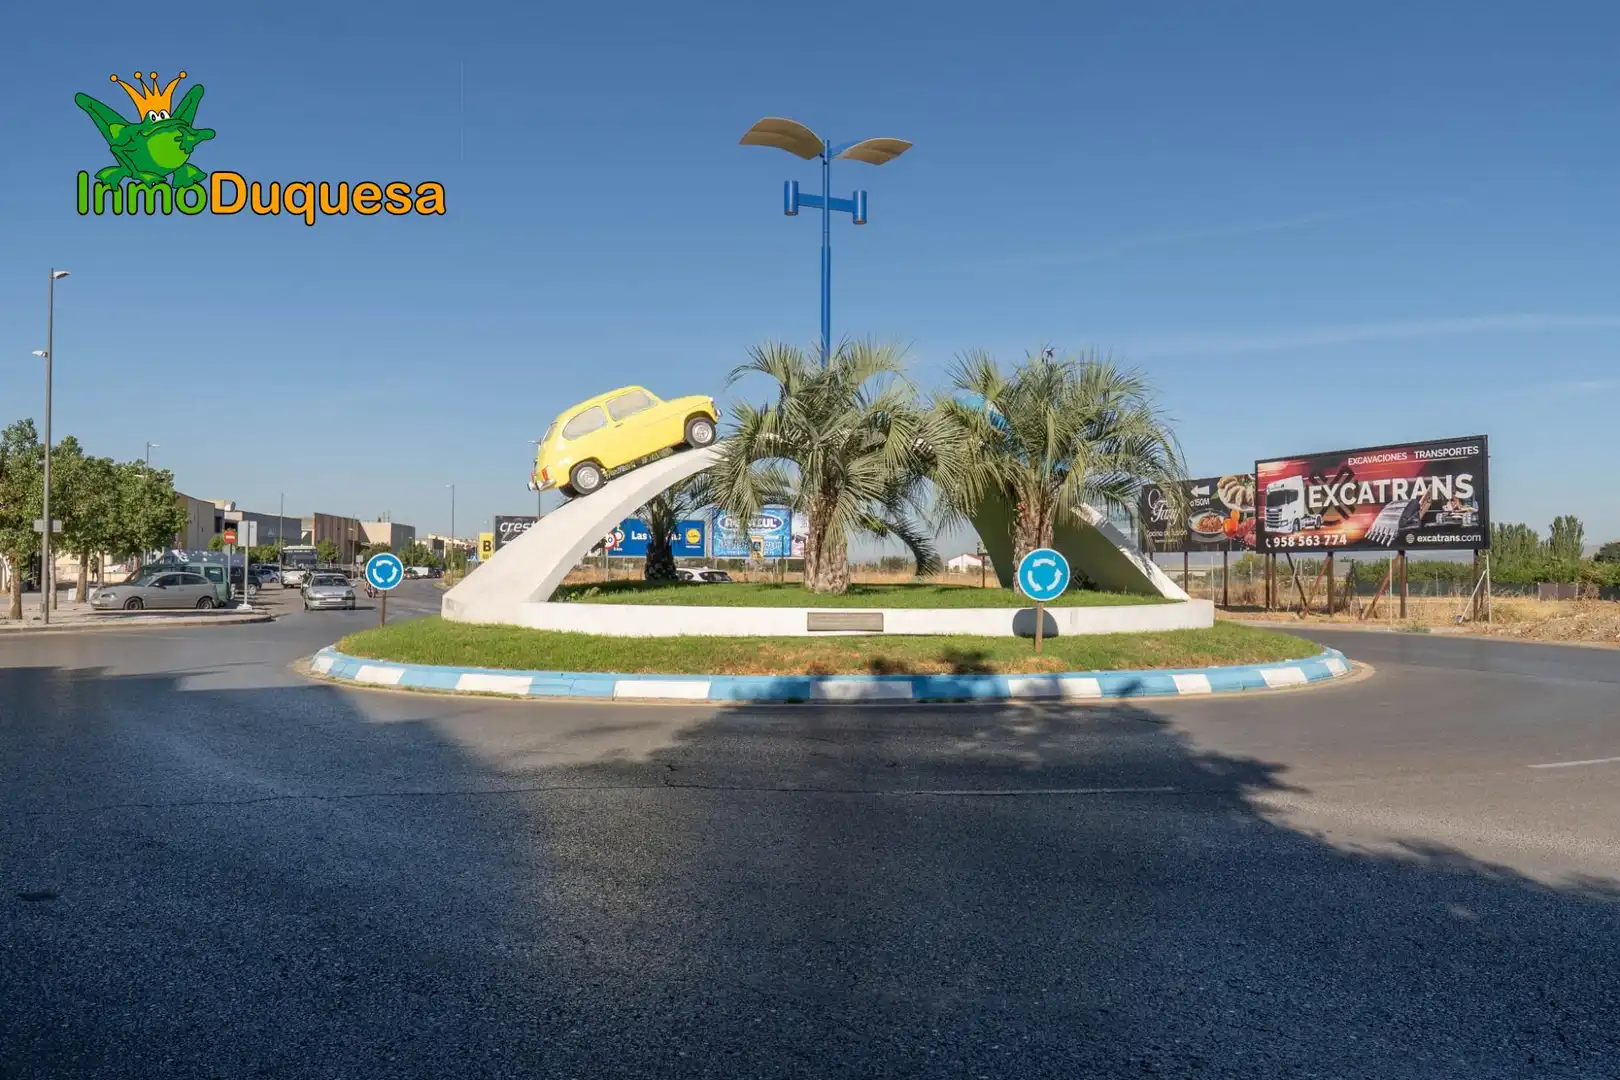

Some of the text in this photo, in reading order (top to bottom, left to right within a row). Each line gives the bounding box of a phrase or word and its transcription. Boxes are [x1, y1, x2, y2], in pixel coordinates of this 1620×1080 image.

[1348, 446, 1479, 466] EXCAVACIONES TRANSPORTES
[1308, 473, 1474, 508] EXCATRANS
[631, 530, 648, 541] Las
[1273, 534, 1347, 548] 958 563 774
[1417, 533, 1482, 543] excatrans.com
